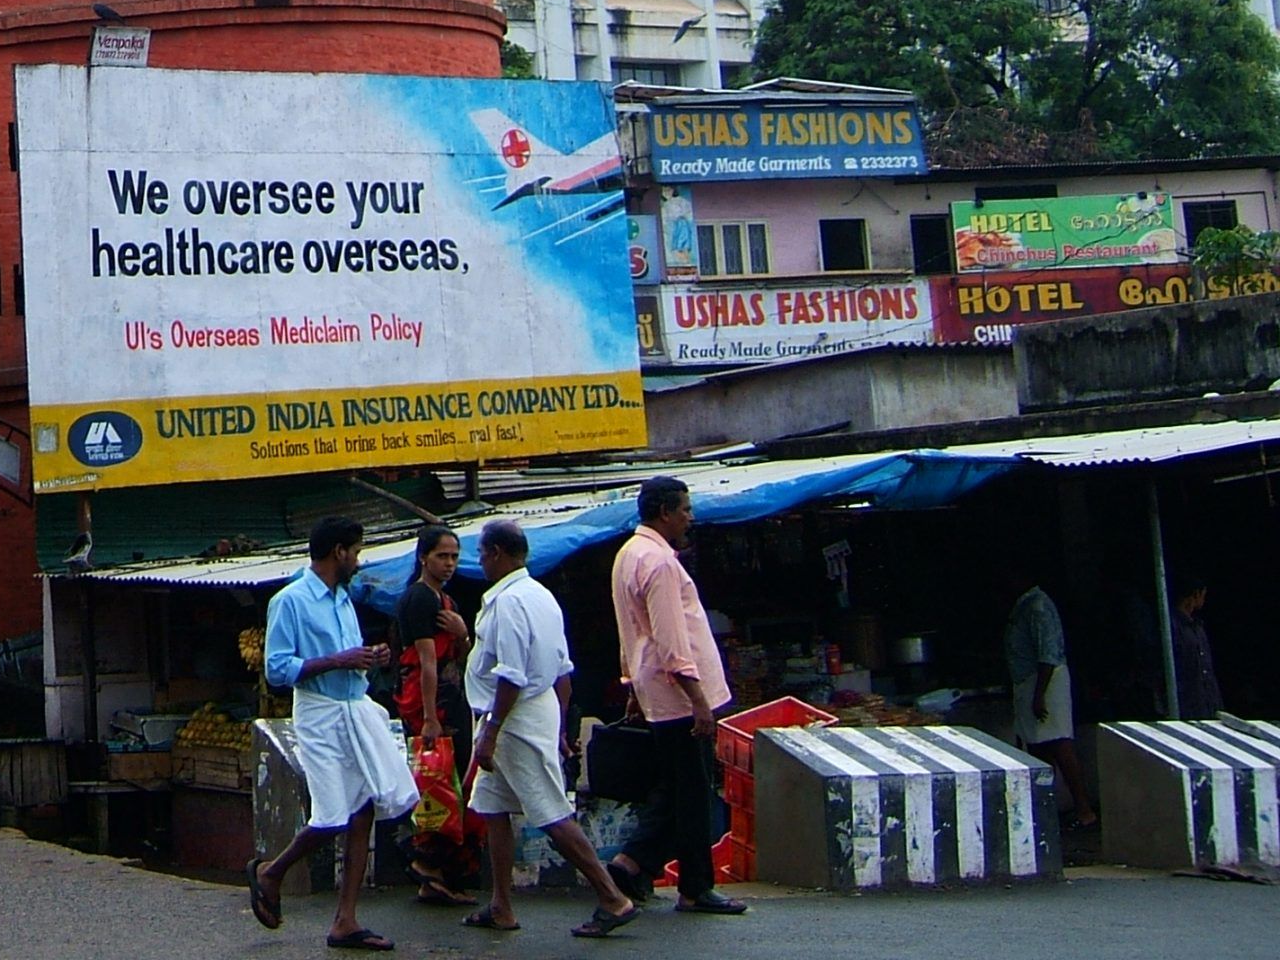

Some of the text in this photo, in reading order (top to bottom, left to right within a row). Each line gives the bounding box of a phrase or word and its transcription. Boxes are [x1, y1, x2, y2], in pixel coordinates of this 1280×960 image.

[653, 111, 914, 147] USHAS FASHIONS
[660, 155, 918, 176] Ready Made Garments 2332373
[108, 169, 425, 229] We oversee your
[970, 212, 1053, 233] HOTEL
[91, 227, 470, 277] healthcare overseas,
[976, 242, 1159, 264] Chinchus Restaurant
[674, 287, 919, 329] USHAS FASHIONS
[958, 282, 1084, 316] HOTEL
[171, 319, 260, 349] Overseas
[270, 316, 361, 346] Mediclaim
[370, 313, 423, 349] Policy
[678, 342, 726, 361] Ready
[728, 341, 772, 357] Made
[155, 406, 256, 439] UNITED
[267, 400, 335, 431] INDIA
[342, 392, 472, 427] INSURANCE
[477, 385, 577, 417] COMPANY
[250, 439, 310, 460] Solutions
[314, 436, 338, 454] that
[345, 434, 377, 452] bring
[381, 432, 410, 450] back
